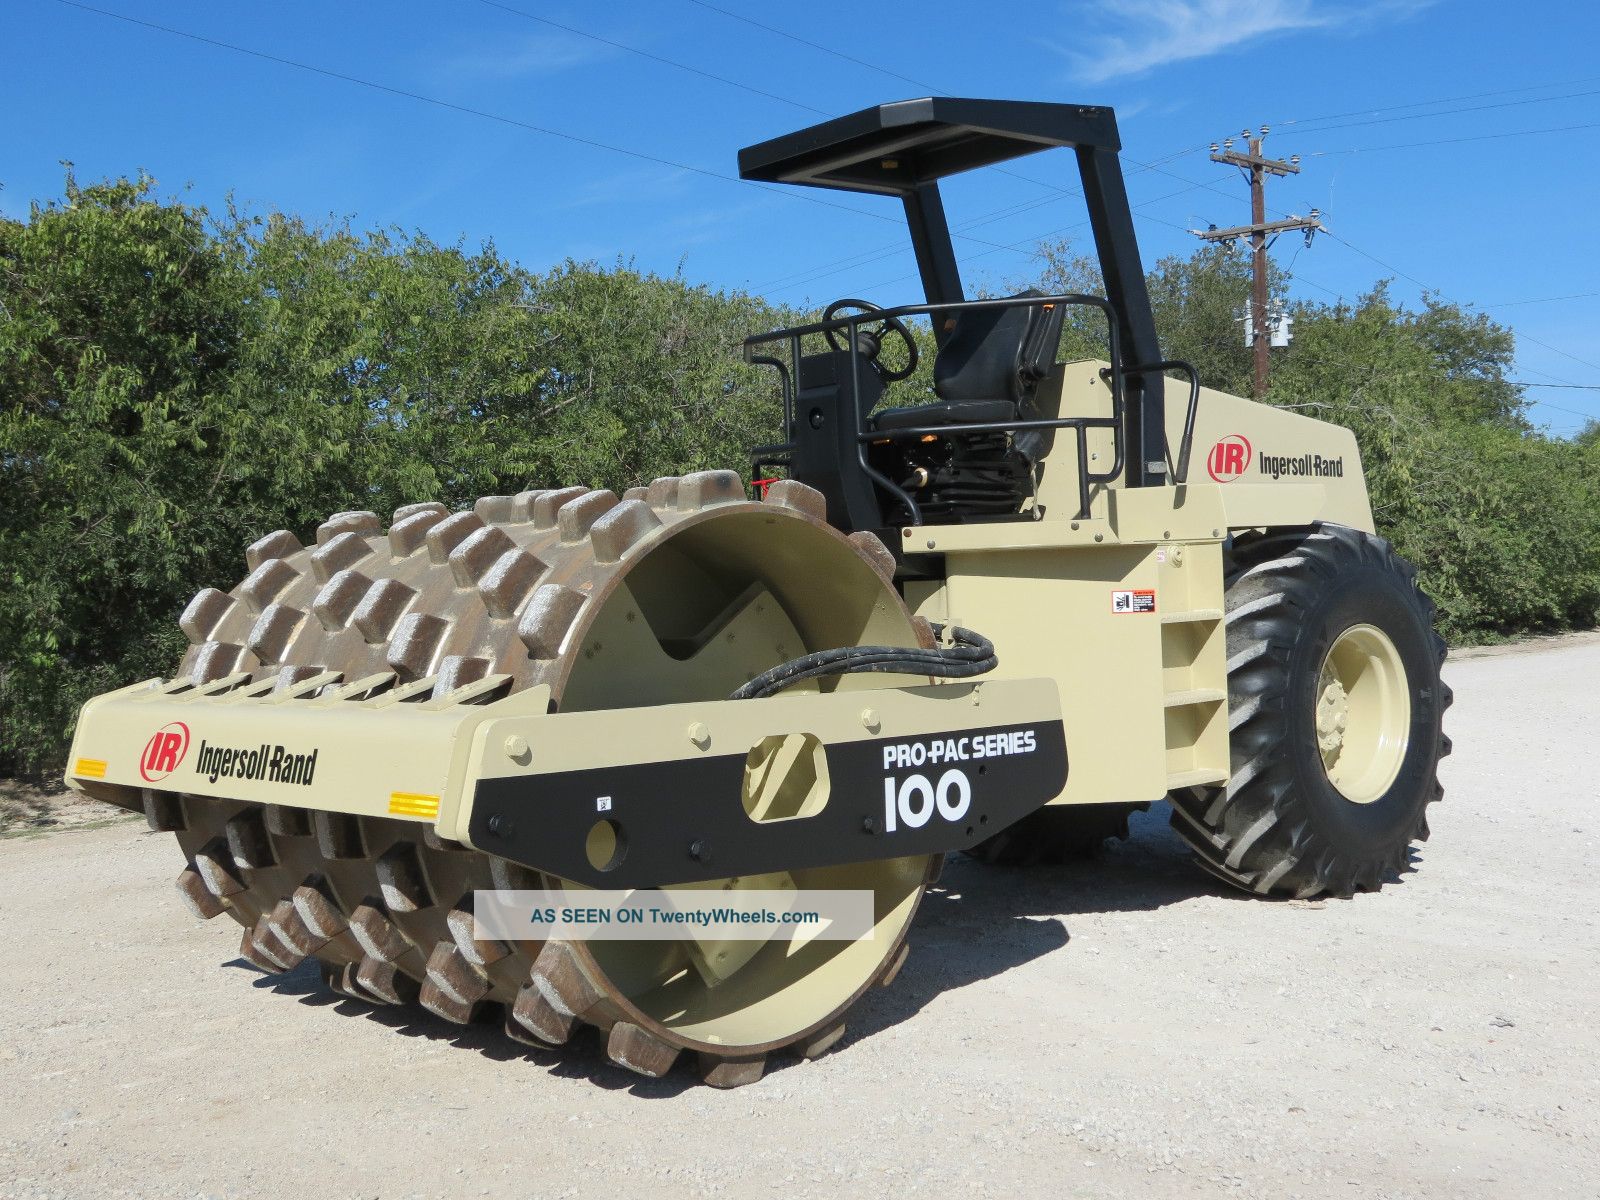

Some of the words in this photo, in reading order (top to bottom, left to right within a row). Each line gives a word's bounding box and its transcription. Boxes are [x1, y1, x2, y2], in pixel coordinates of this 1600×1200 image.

[1214, 442, 1245, 475] IR
[145, 731, 182, 772] IR
[883, 737, 970, 770] PRO-PAC
[972, 730, 1037, 759] SERIES
[884, 768, 972, 833] 100
